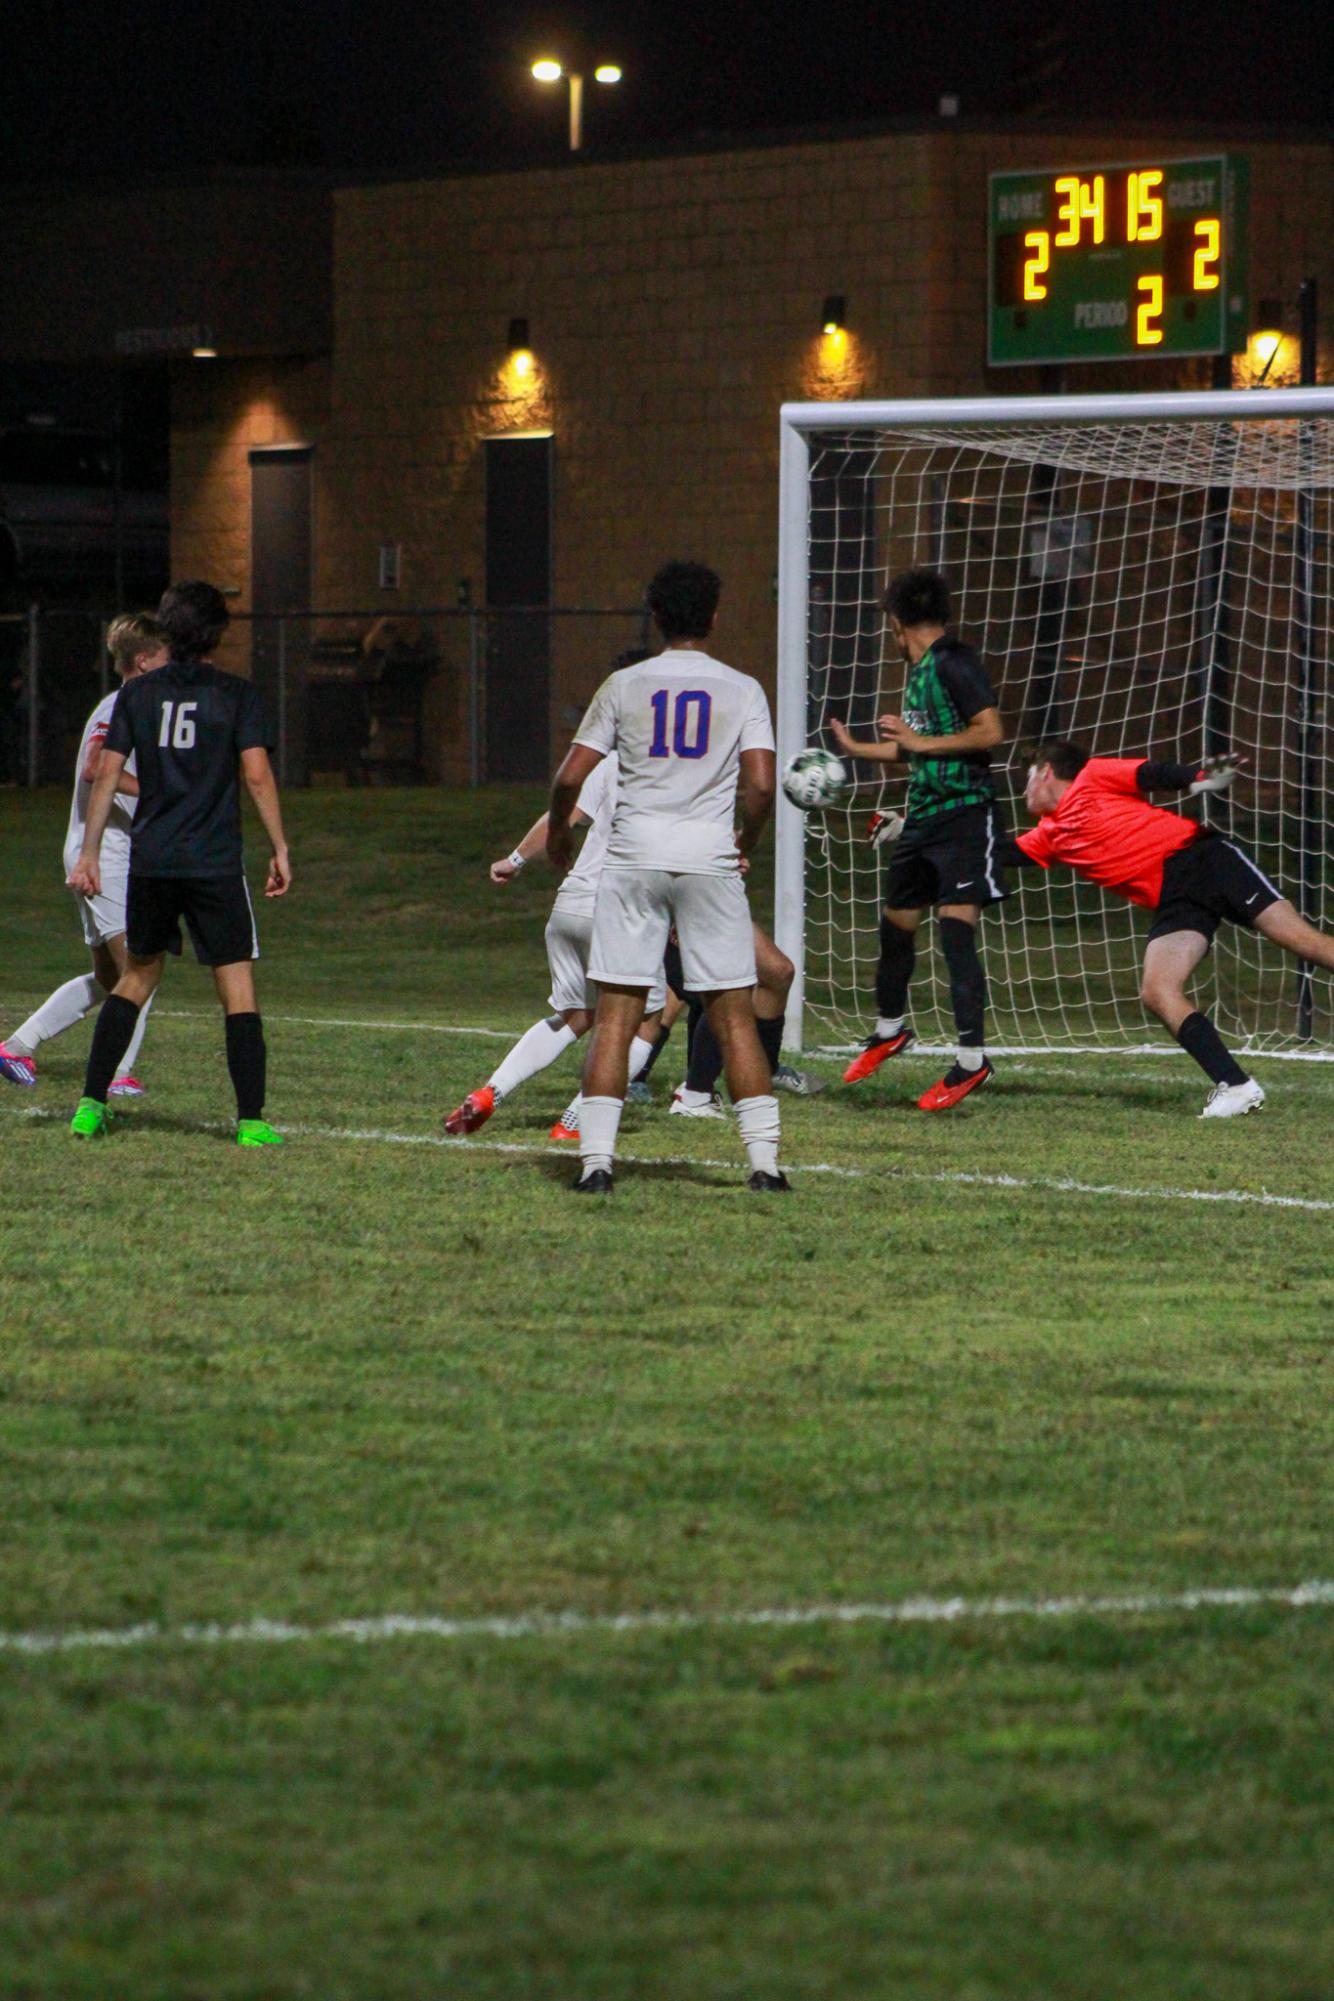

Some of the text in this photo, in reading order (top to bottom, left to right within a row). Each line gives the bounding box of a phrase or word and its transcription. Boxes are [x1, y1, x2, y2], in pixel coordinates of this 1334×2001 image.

[1055, 175, 1104, 247] 34
[1127, 170, 1163, 242] 15
[1024, 231, 1049, 300] 2
[1193, 219, 1220, 290] 2
[1074, 301, 1128, 329] PERIOD
[1137, 275, 1163, 345] 2
[158, 700, 198, 749] 16
[648, 690, 712, 759] 10
